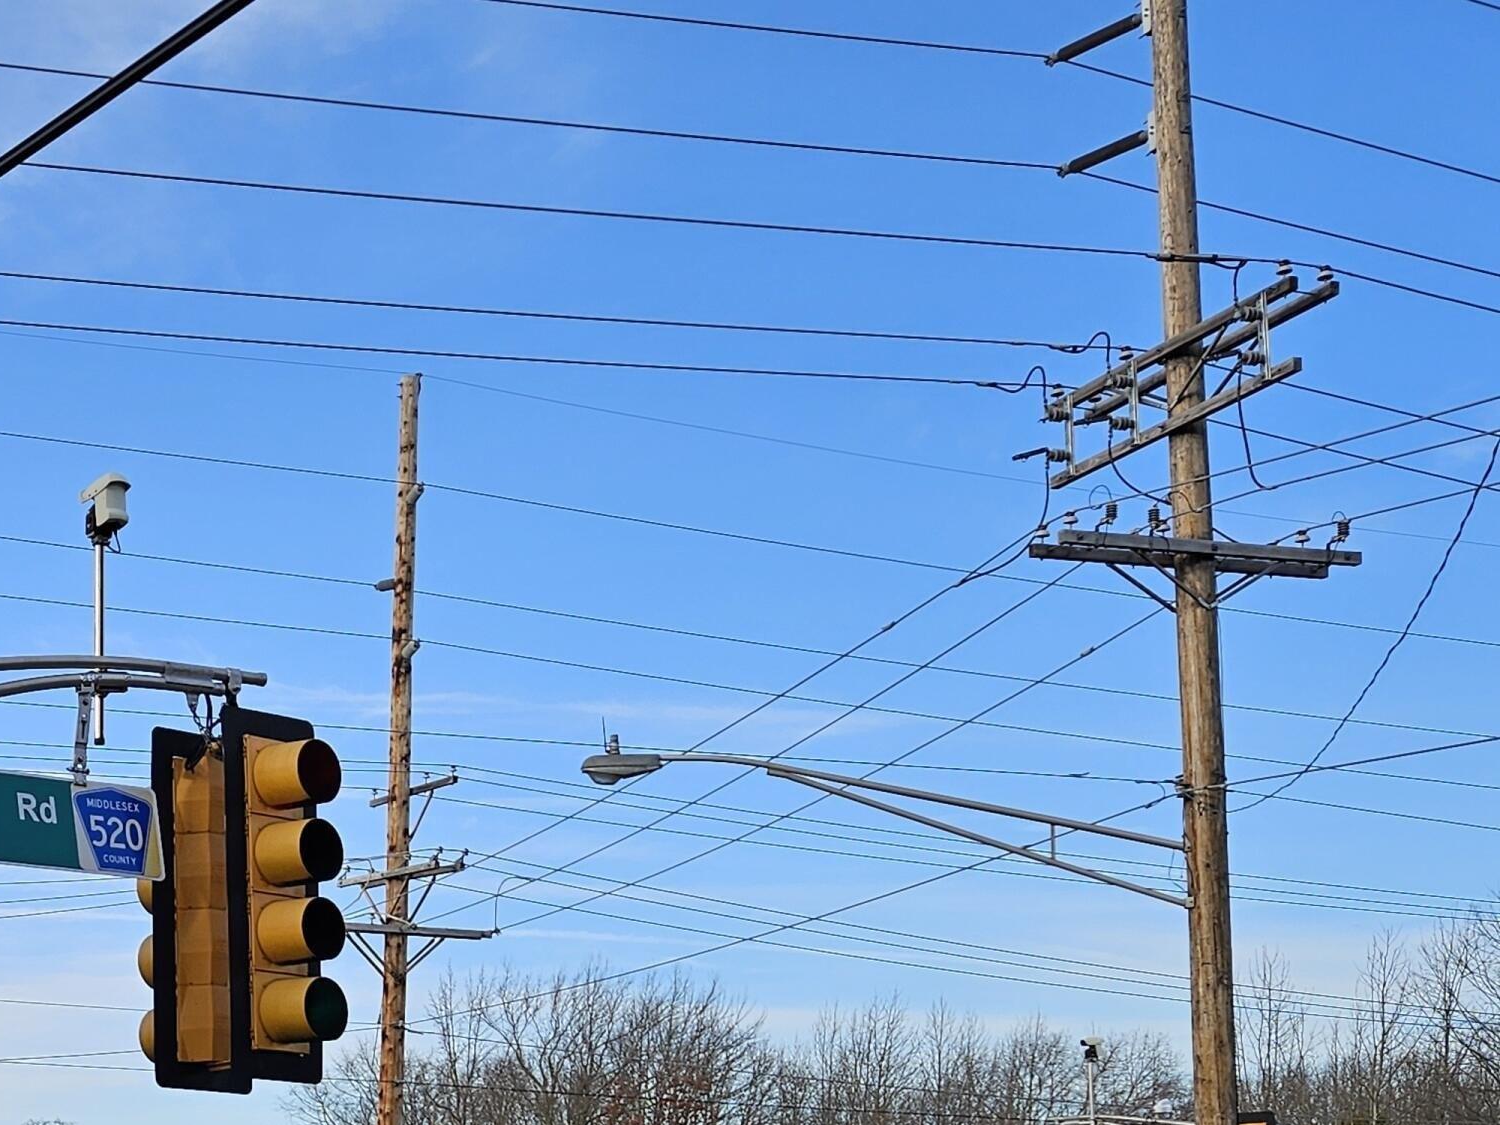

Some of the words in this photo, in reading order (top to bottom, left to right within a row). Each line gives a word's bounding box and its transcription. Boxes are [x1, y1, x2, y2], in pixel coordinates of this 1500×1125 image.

[16, 791, 58, 824] Rd
[86, 797, 140, 813] MIDDLESEX
[89, 814, 144, 851] 520
[103, 854, 137, 866] COUNTY
